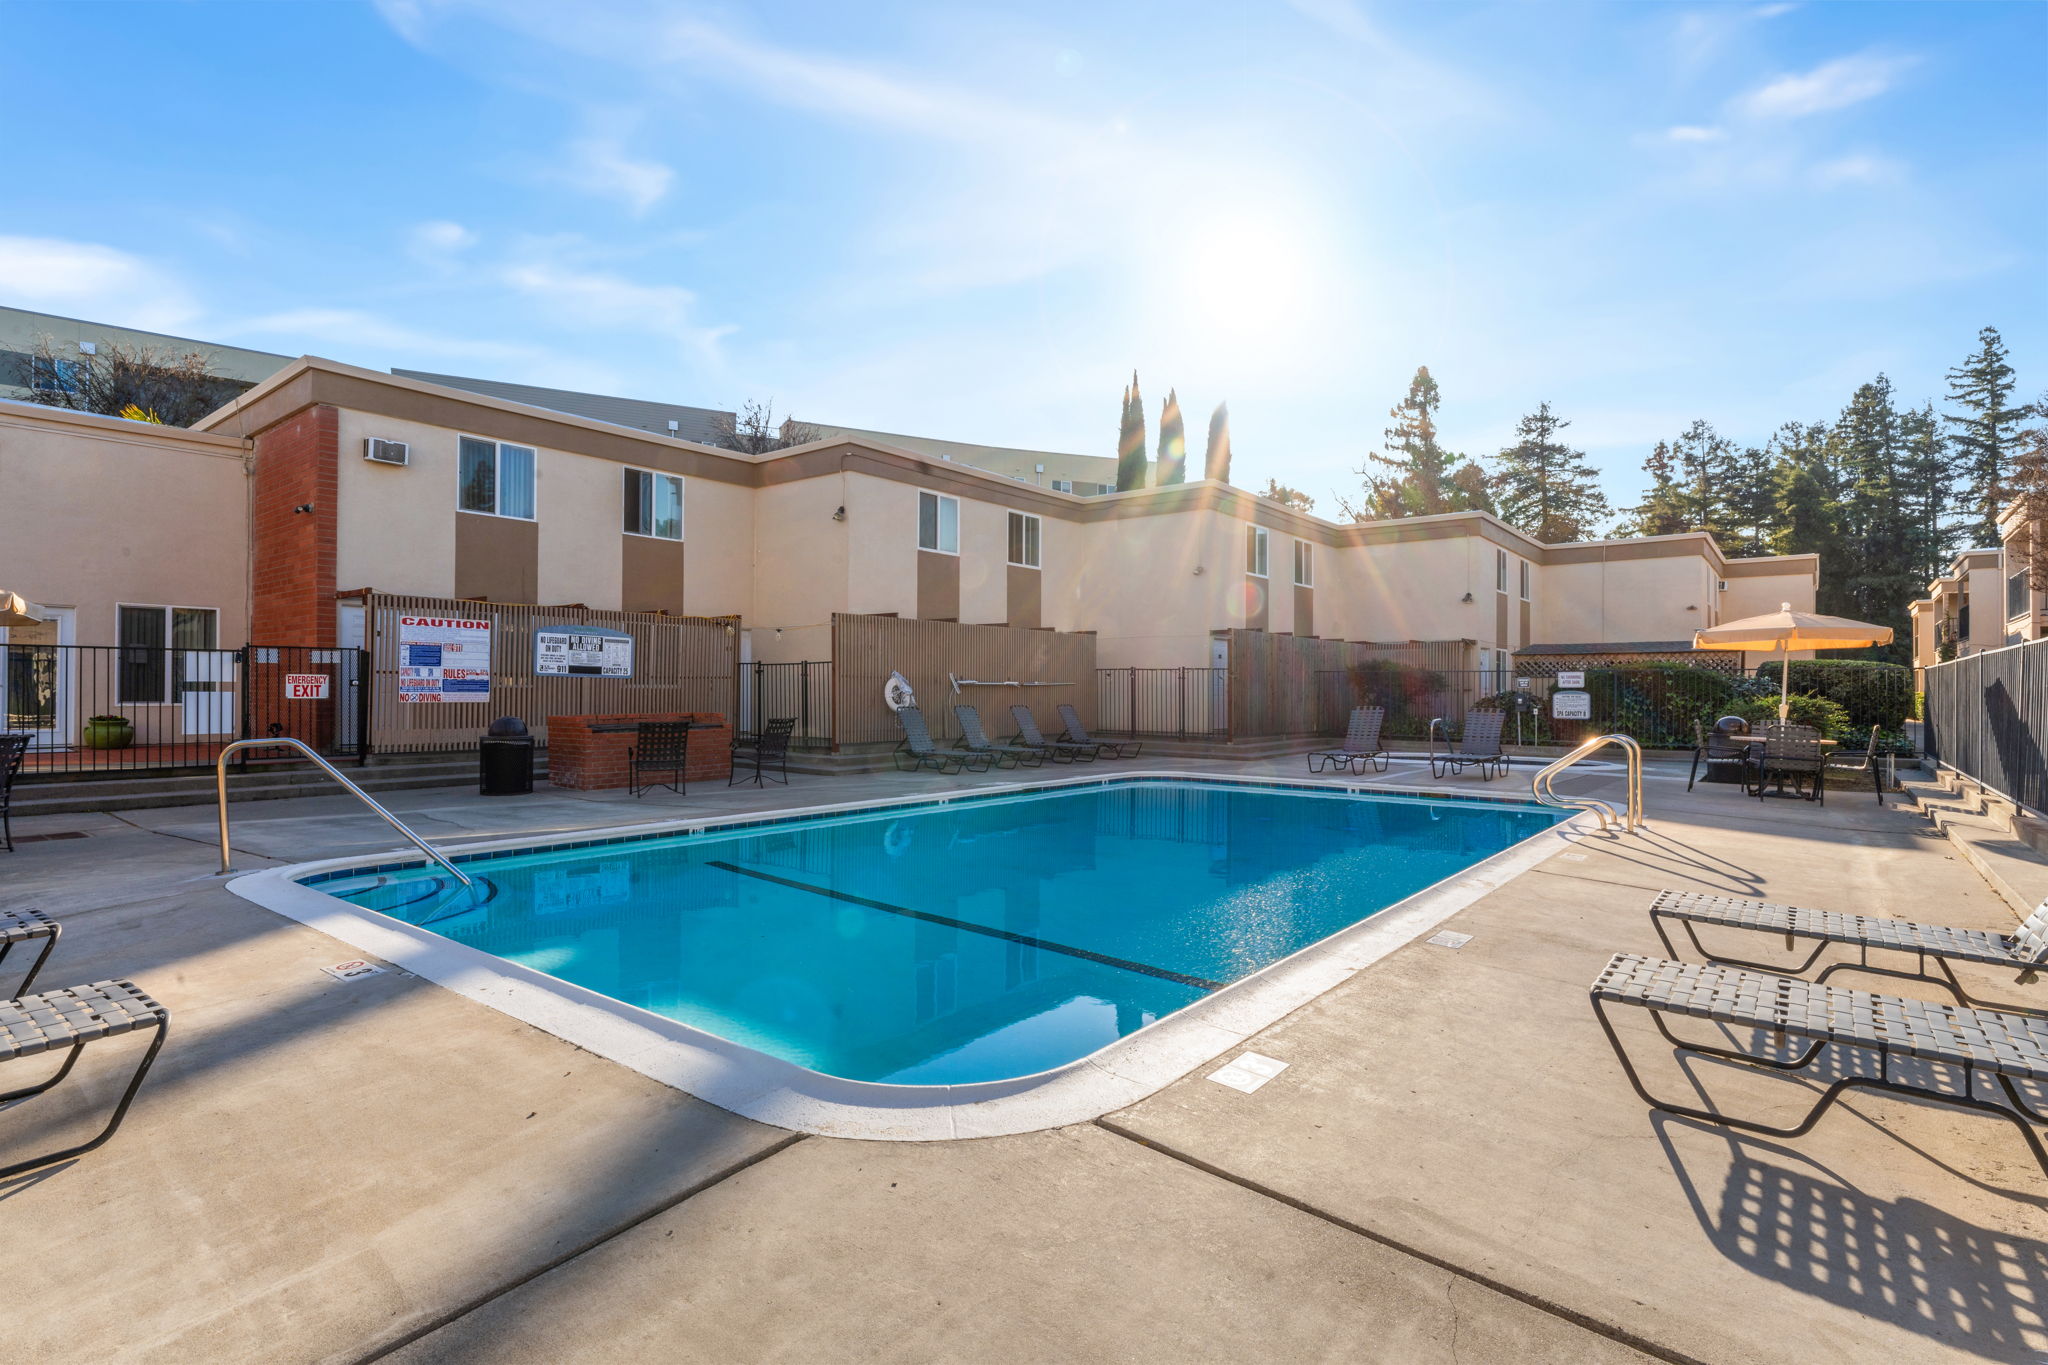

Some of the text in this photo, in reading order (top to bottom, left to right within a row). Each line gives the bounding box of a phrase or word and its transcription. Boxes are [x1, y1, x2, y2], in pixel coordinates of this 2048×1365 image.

[401, 617, 489, 630] CAUTION
[546, 636, 567, 645] LIFEGUARD
[570, 636, 580, 644] NO
[581, 636, 602, 645] DIVING
[572, 643, 600, 652] ALLOWED
[443, 668, 466, 679] RULES
[556, 665, 567, 673] 911
[602, 667, 622, 675] CAPACITY
[287, 675, 328, 685] EMERGENCY
[293, 685, 322, 698] EXIT
[400, 693, 410, 702] NO
[419, 693, 441, 702] DIVING
